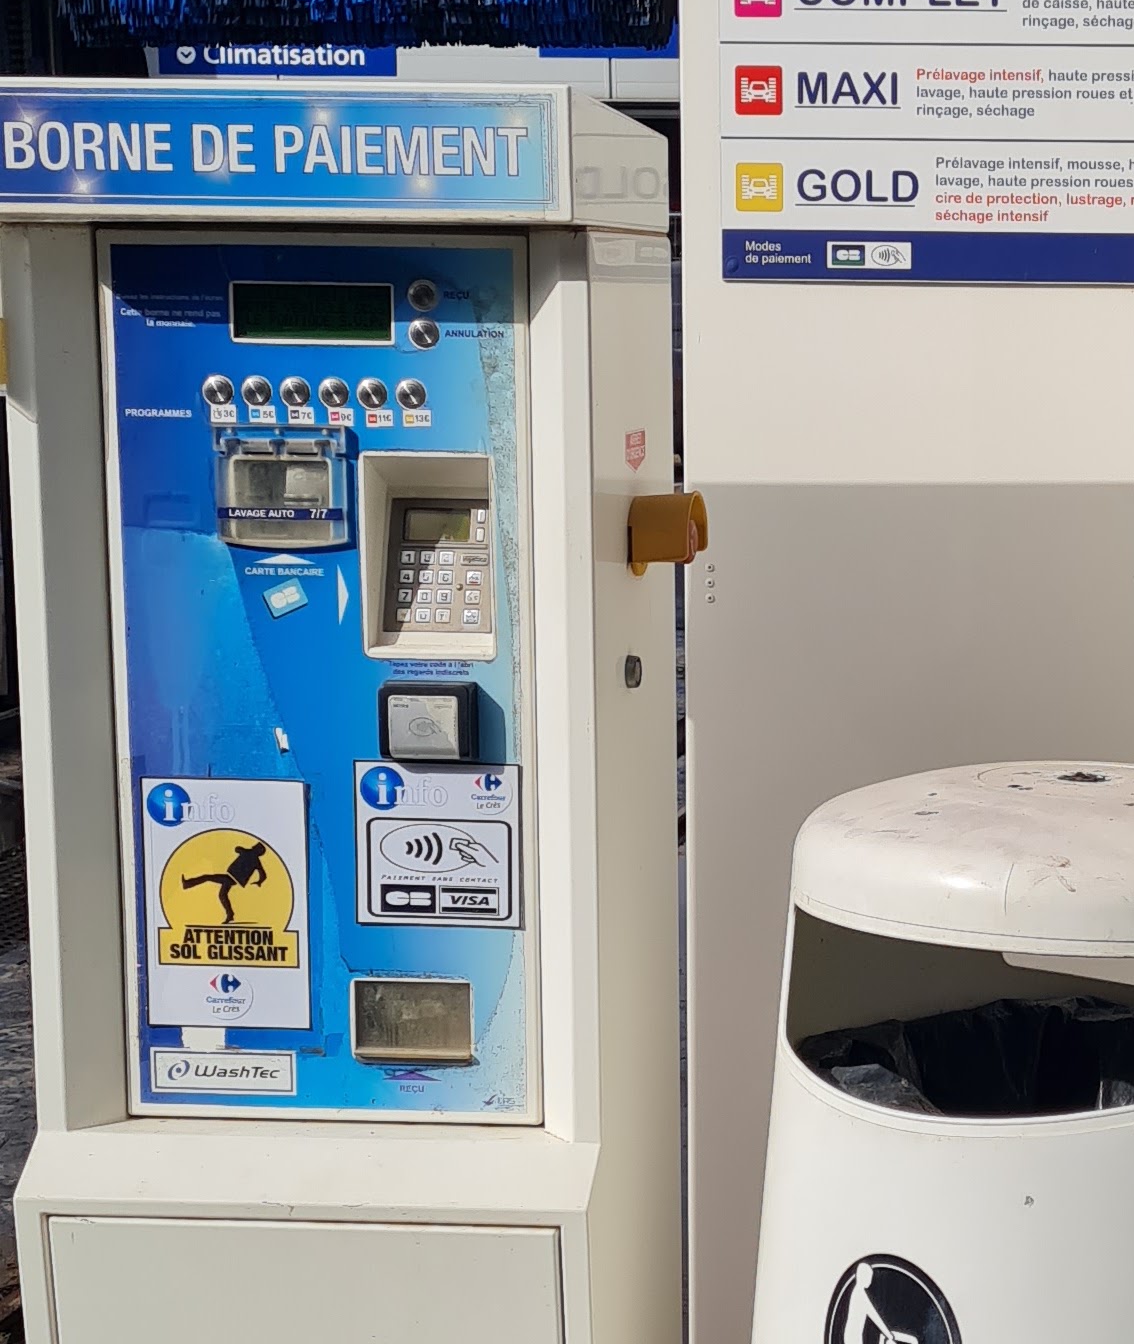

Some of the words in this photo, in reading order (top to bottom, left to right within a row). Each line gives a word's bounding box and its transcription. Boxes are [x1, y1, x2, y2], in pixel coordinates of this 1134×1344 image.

[1022, 14, 1079, 29] rinçage,
[203, 43, 366, 66] Climatisation
[916, 68, 986, 84] Prélavage
[989, 68, 1044, 83] intensif,
[1048, 69, 1088, 82] haute
[796, 71, 899, 106] MAXI
[916, 86, 965, 101] lavage,
[969, 86, 1008, 99] haute
[1012, 86, 1072, 102] pression
[1076, 88, 1116, 100] roues
[1119, 87, 1134, 100] et
[916, 104, 973, 119] rinçage,
[976, 104, 1035, 120] séchage
[2, 120, 175, 172] BORNE
[191, 122, 256, 174] DE
[273, 124, 529, 177] PAIEMENT
[935, 157, 1005, 172] Prélavage
[1008, 157, 1063, 172] intensif,
[1067, 160, 1125, 172] mousse,
[796, 169, 920, 204] GOLD
[935, 174, 984, 189] lavage,
[988, 175, 1027, 188] haute
[1030, 175, 1091, 191] pression
[1094, 178, 1134, 189] roues
[935, 193, 962, 205] cire
[965, 192, 983, 205] de
[986, 193, 1062, 208] protection,
[1066, 193, 1127, 209] lustrage,
[935, 210, 993, 225] séchage
[997, 210, 1049, 224] intensif
[745, 240, 782, 252] Modes
[745, 253, 759, 264] de
[761, 253, 812, 266] paiement
[443, 290, 470, 301] REÇU
[444, 329, 505, 339] ANNULATION
[124, 407, 193, 419] PROGRAMMES
[228, 508, 267, 518] LAVAGE
[268, 509, 295, 518] AUTO
[309, 508, 328, 519] 7/7
[244, 567, 277, 576] CARTE
[277, 567, 325, 577] BANCAIRE
[449, 894, 490, 906] VISA
[182, 927, 274, 946] ATTENTION
[169, 943, 202, 961] SOL
[207, 944, 289, 962] GLISSANT
[194, 1064, 280, 1079] WashTec
